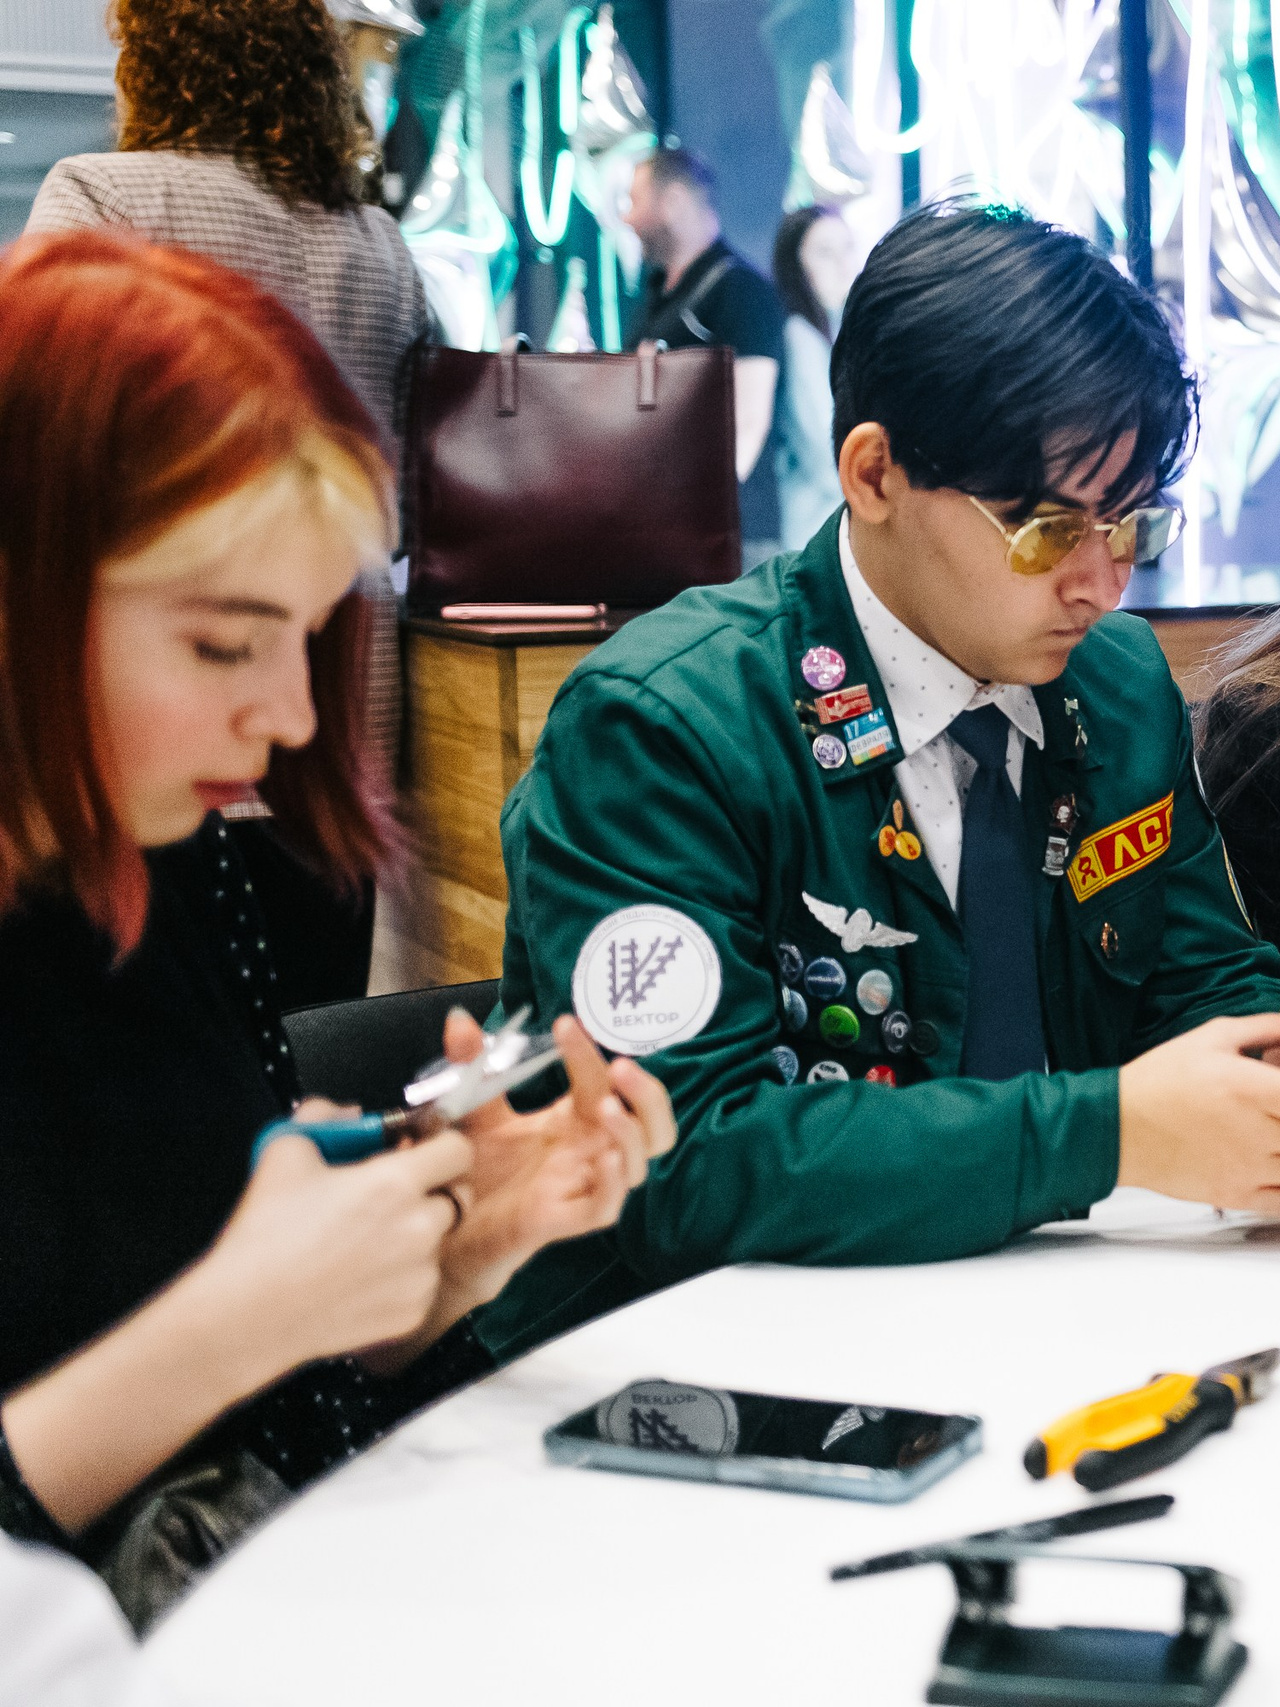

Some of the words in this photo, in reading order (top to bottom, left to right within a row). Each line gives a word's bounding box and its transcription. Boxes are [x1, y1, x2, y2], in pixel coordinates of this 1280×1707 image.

[844, 720, 860, 740] 17
[1114, 802, 1173, 870] ЛС
[613, 1012, 680, 1027] ВЕКТОР
